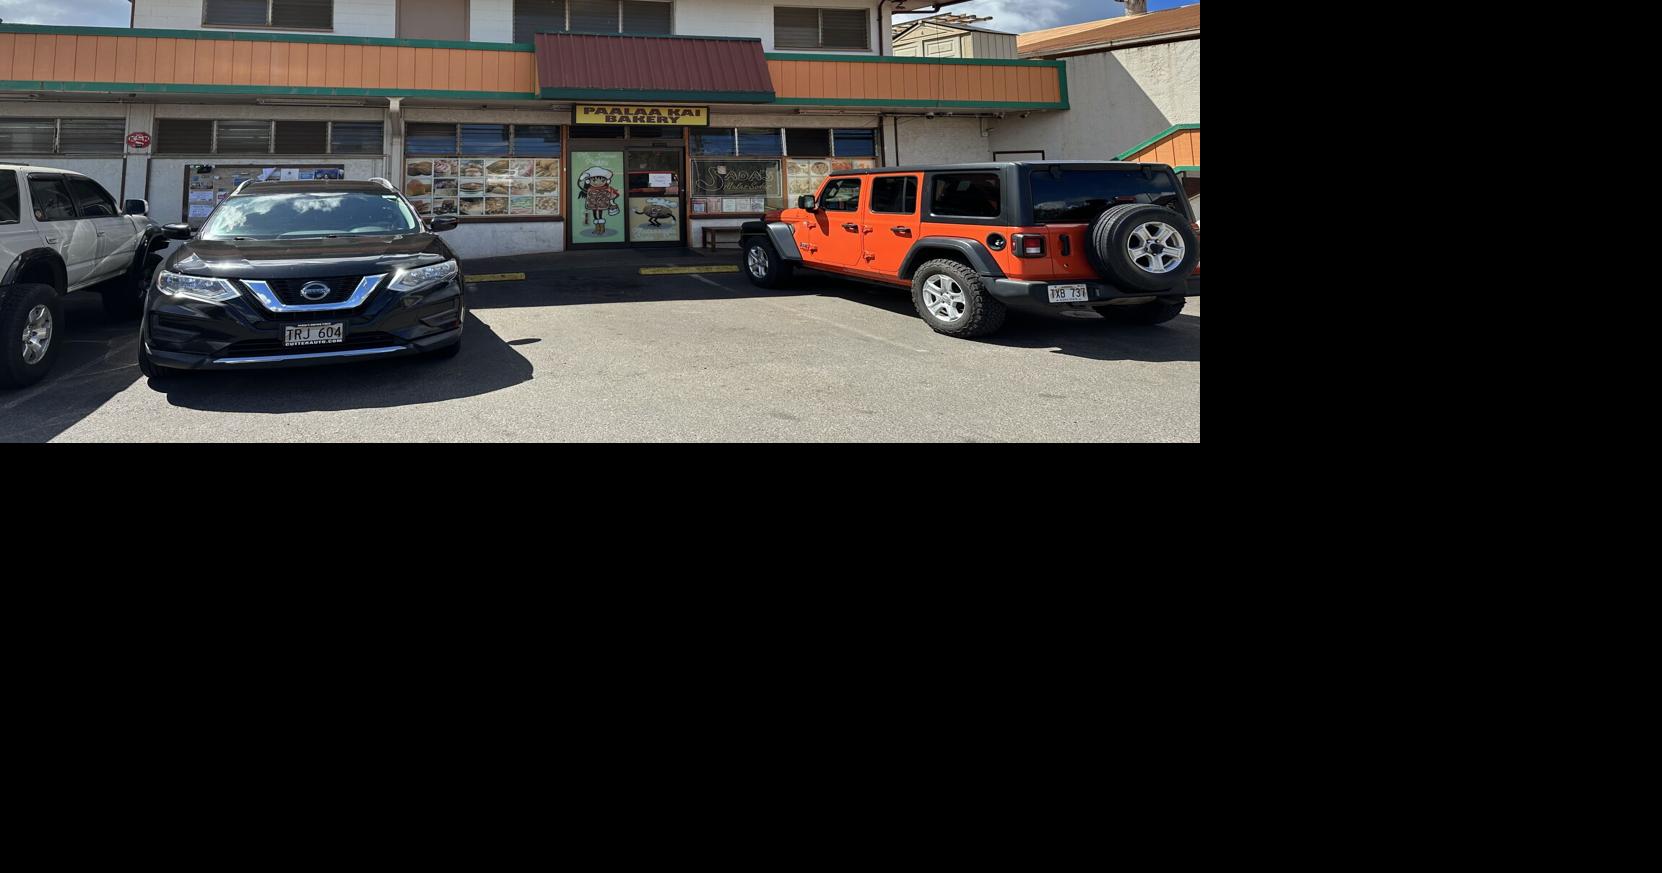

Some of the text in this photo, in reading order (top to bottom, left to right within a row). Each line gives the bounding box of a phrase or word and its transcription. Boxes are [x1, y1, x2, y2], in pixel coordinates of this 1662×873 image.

[583, 107, 701, 117] PAALAA KAI
[605, 115, 680, 124] BAKERY
[1050, 287, 1085, 299] TXB 737
[286, 327, 341, 341] TRJ 604
